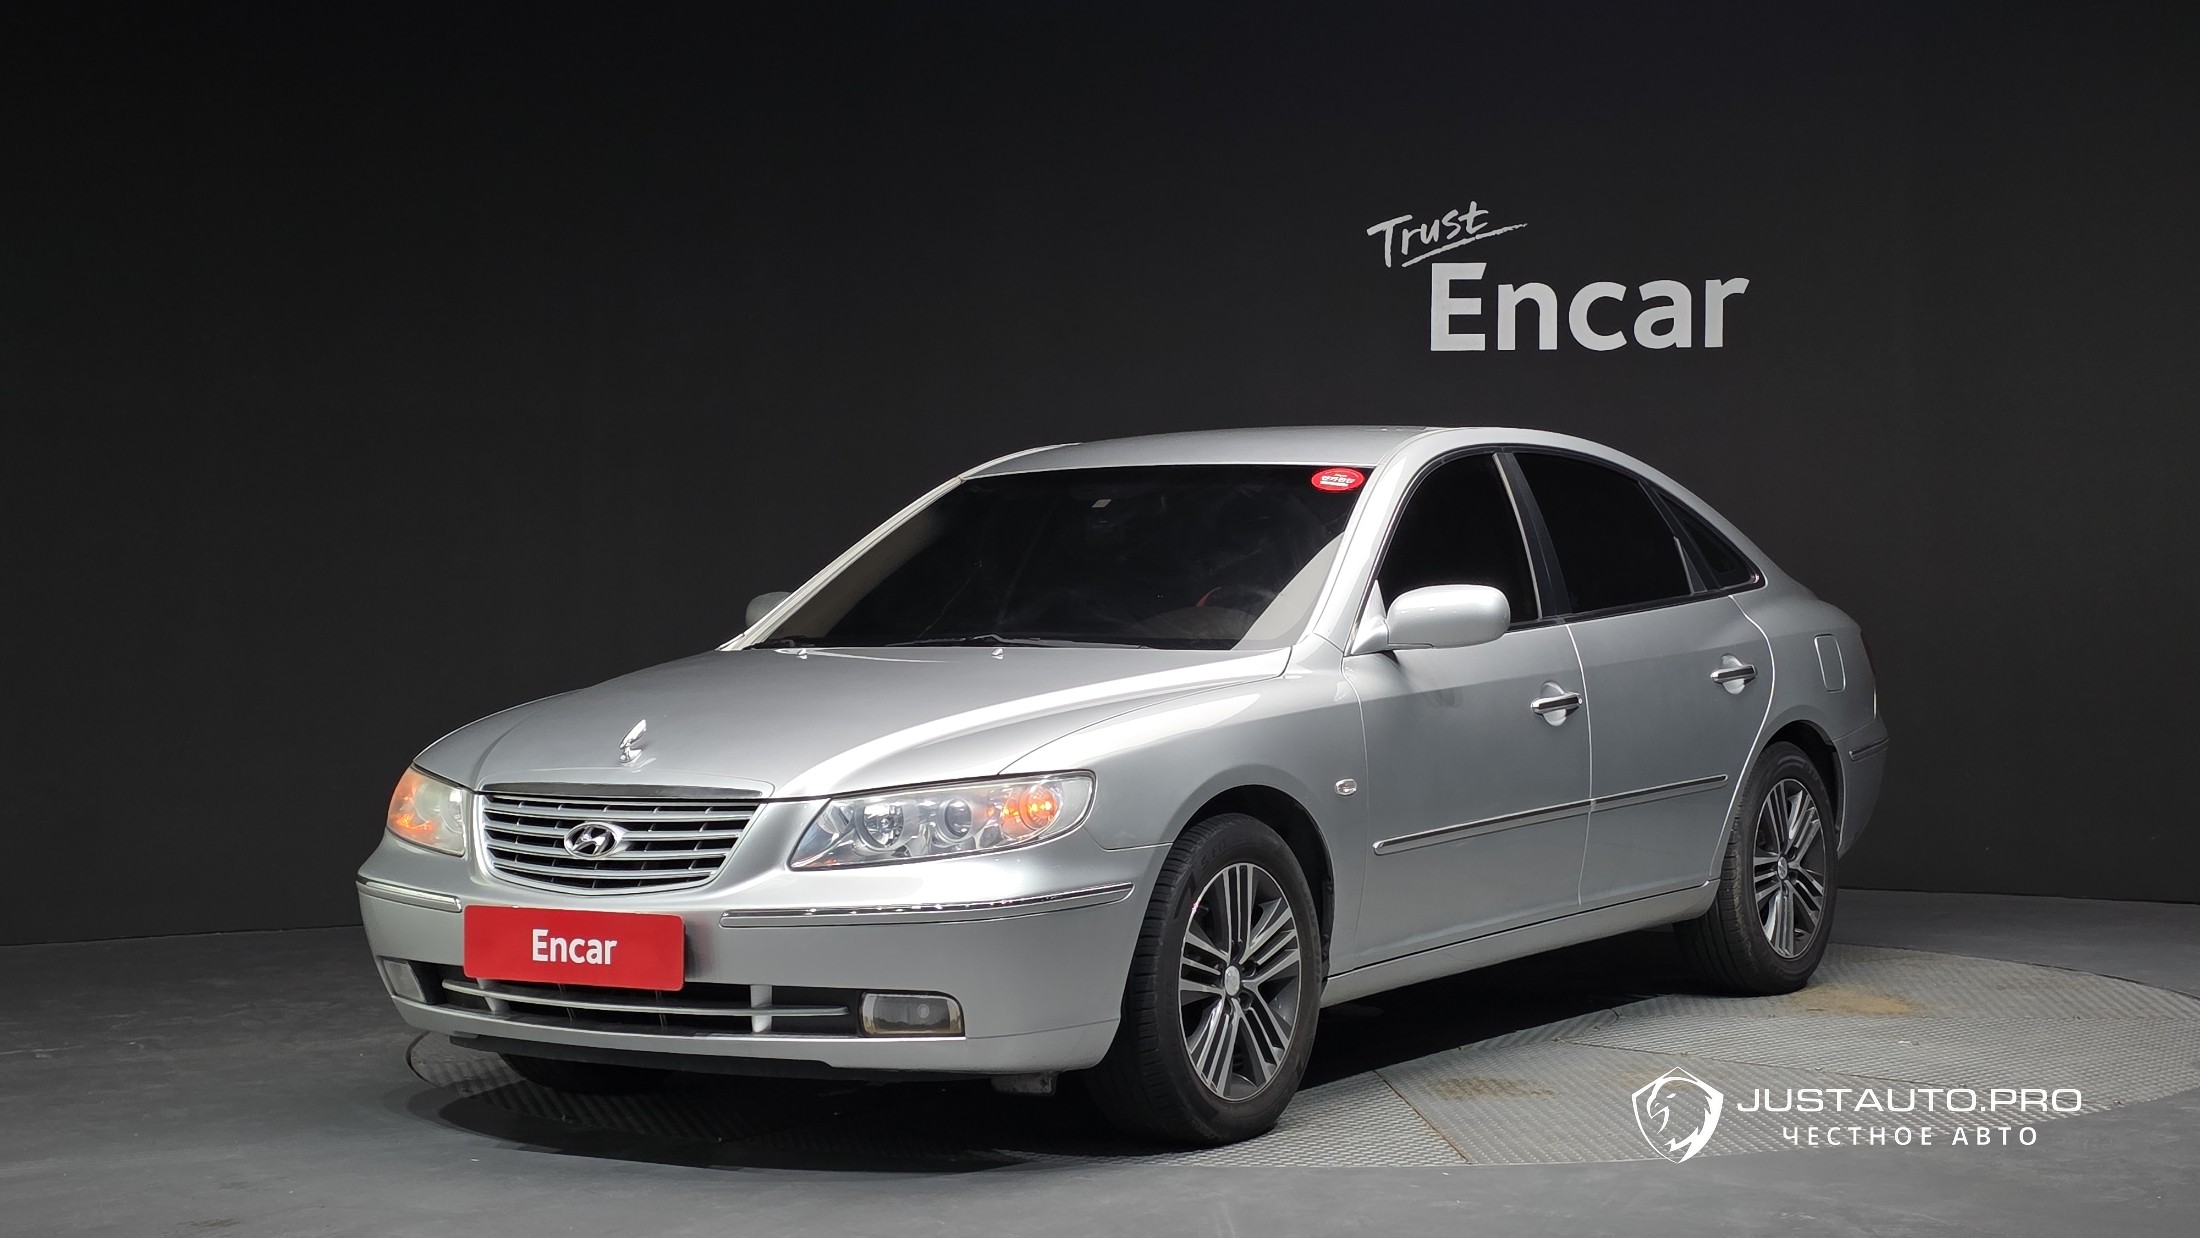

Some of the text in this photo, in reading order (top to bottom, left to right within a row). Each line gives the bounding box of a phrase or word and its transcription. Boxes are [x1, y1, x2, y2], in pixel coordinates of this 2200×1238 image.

[1366, 200, 1490, 268] Trust
[1430, 261, 1750, 352] Encar
[532, 928, 618, 965] Encar
